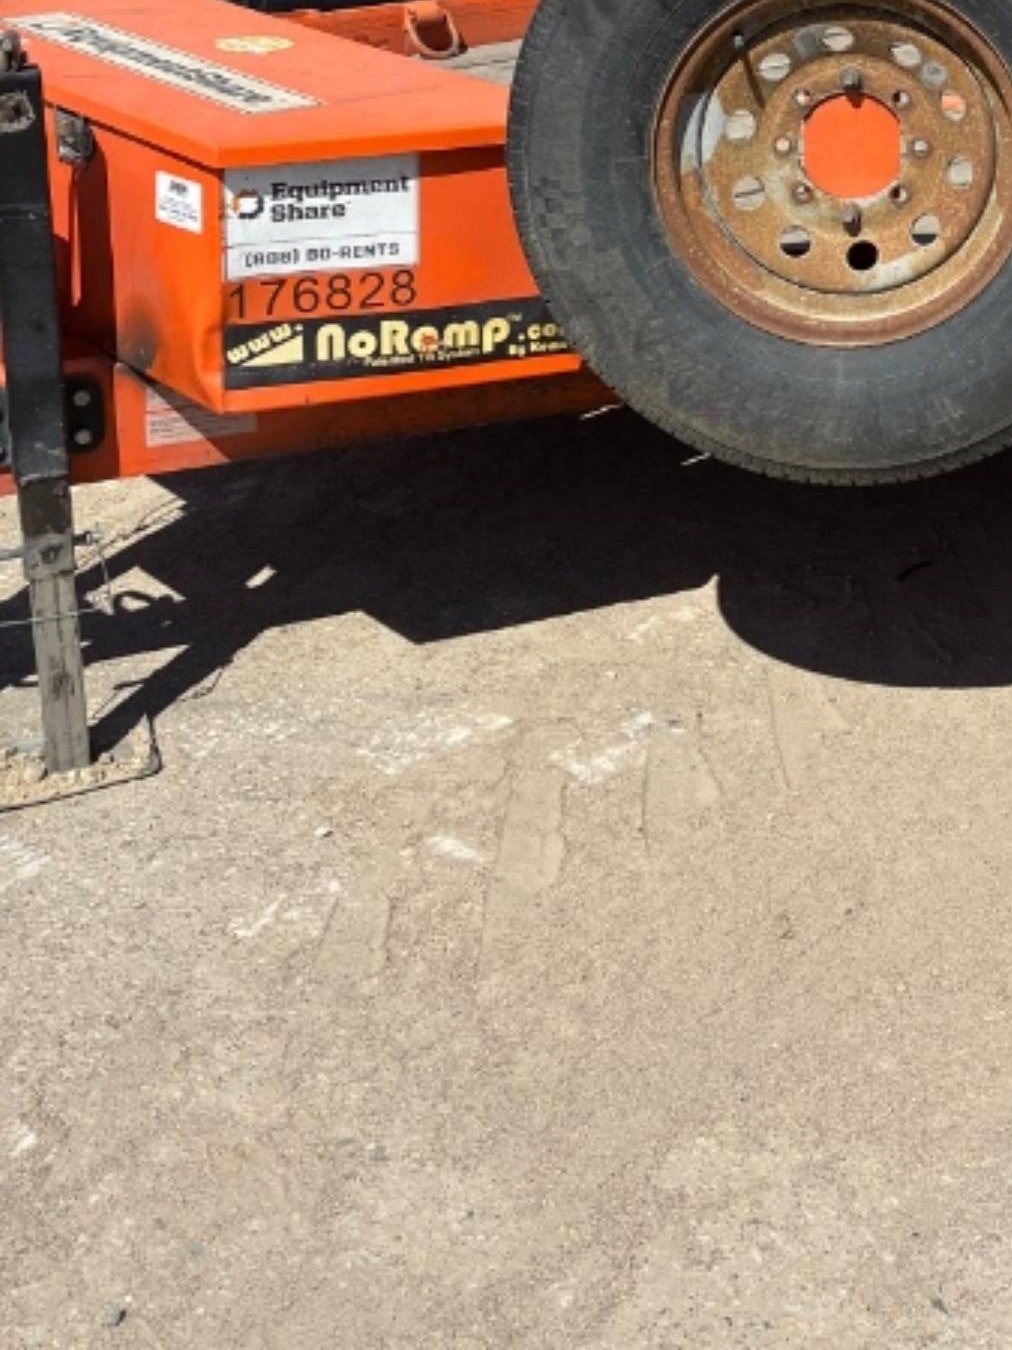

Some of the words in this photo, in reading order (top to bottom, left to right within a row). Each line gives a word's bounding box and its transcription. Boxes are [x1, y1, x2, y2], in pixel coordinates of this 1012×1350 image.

[270, 176, 411, 202] Equipment
[271, 203, 346, 224] Share
[229, 270, 416, 319] 176828
